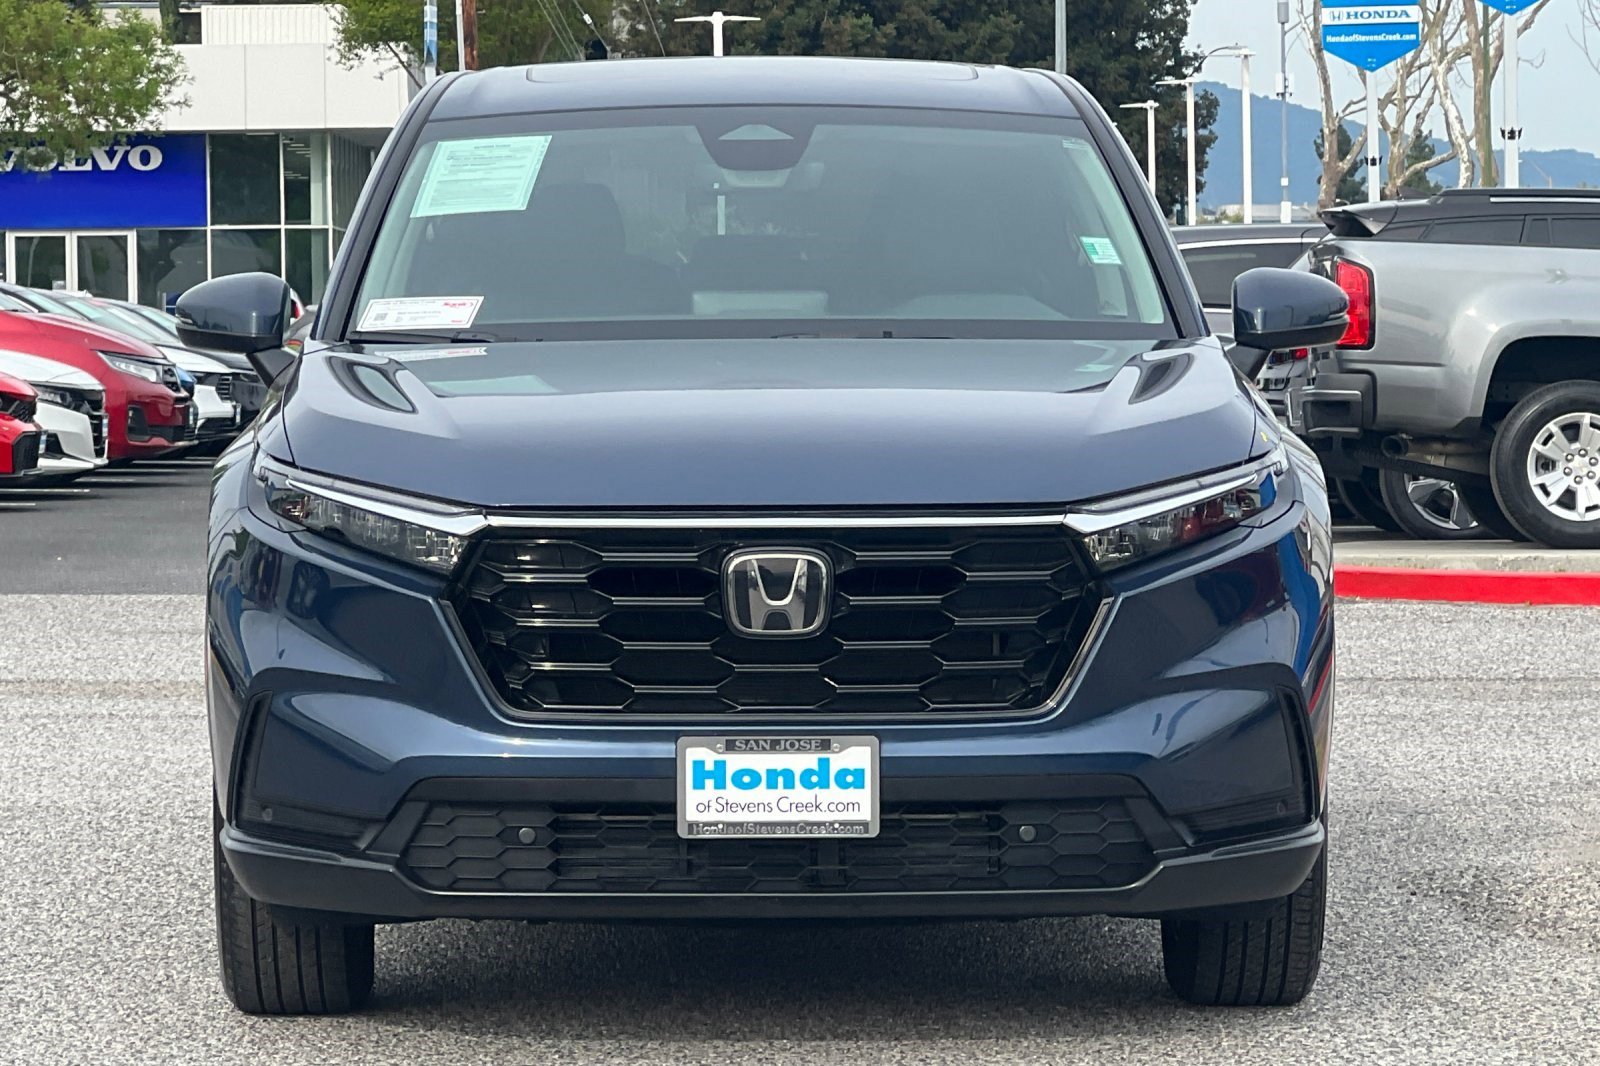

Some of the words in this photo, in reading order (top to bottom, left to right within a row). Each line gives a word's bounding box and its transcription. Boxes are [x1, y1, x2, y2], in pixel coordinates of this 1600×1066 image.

[1345, 9, 1411, 20] HONDA
[1326, 32, 1417, 43] HondaofStevensCreek.com
[734, 739, 771, 751] SAN
[775, 739, 822, 751] JOSE
[692, 757, 865, 790] Honda
[695, 799, 712, 814] of
[715, 796, 773, 814] Stevens
[776, 794, 861, 813] Creek.com
